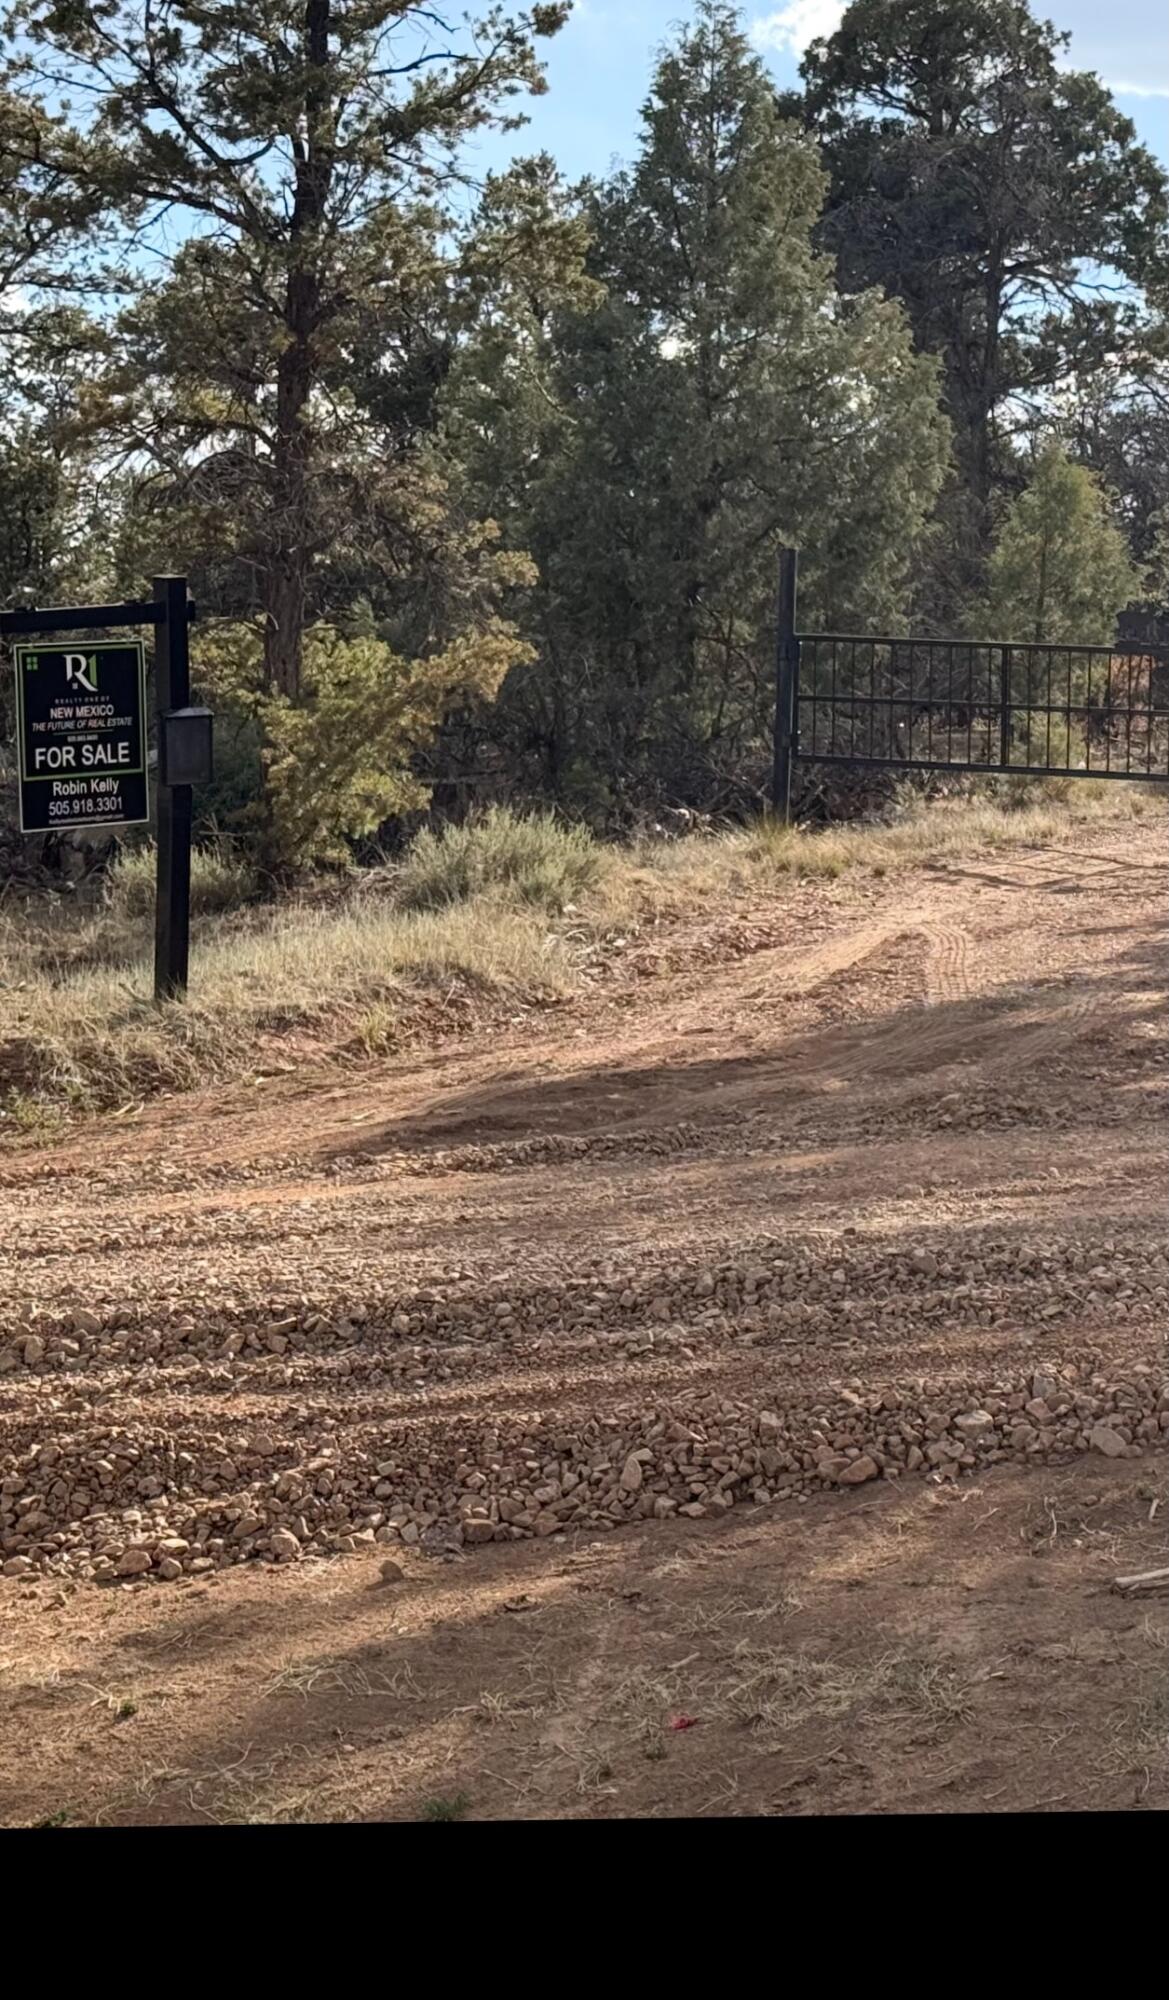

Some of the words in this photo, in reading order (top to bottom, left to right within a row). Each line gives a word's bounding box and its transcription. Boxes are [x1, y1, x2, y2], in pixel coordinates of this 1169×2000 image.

[50, 706, 74, 719] NEW
[75, 704, 114, 718] MEXICO
[32, 722, 46, 732] THE
[47, 720, 75, 731] FUTURE
[76, 719, 87, 729] OF
[88, 718, 106, 728] REAL
[106, 716, 133, 727] ESTATE
[35, 746, 76, 769] FOR
[81, 742, 130, 765] SALE
[53, 780, 87, 796] Robin
[90, 777, 120, 795] Kelly
[48, 796, 122, 815] 505.918.3301
